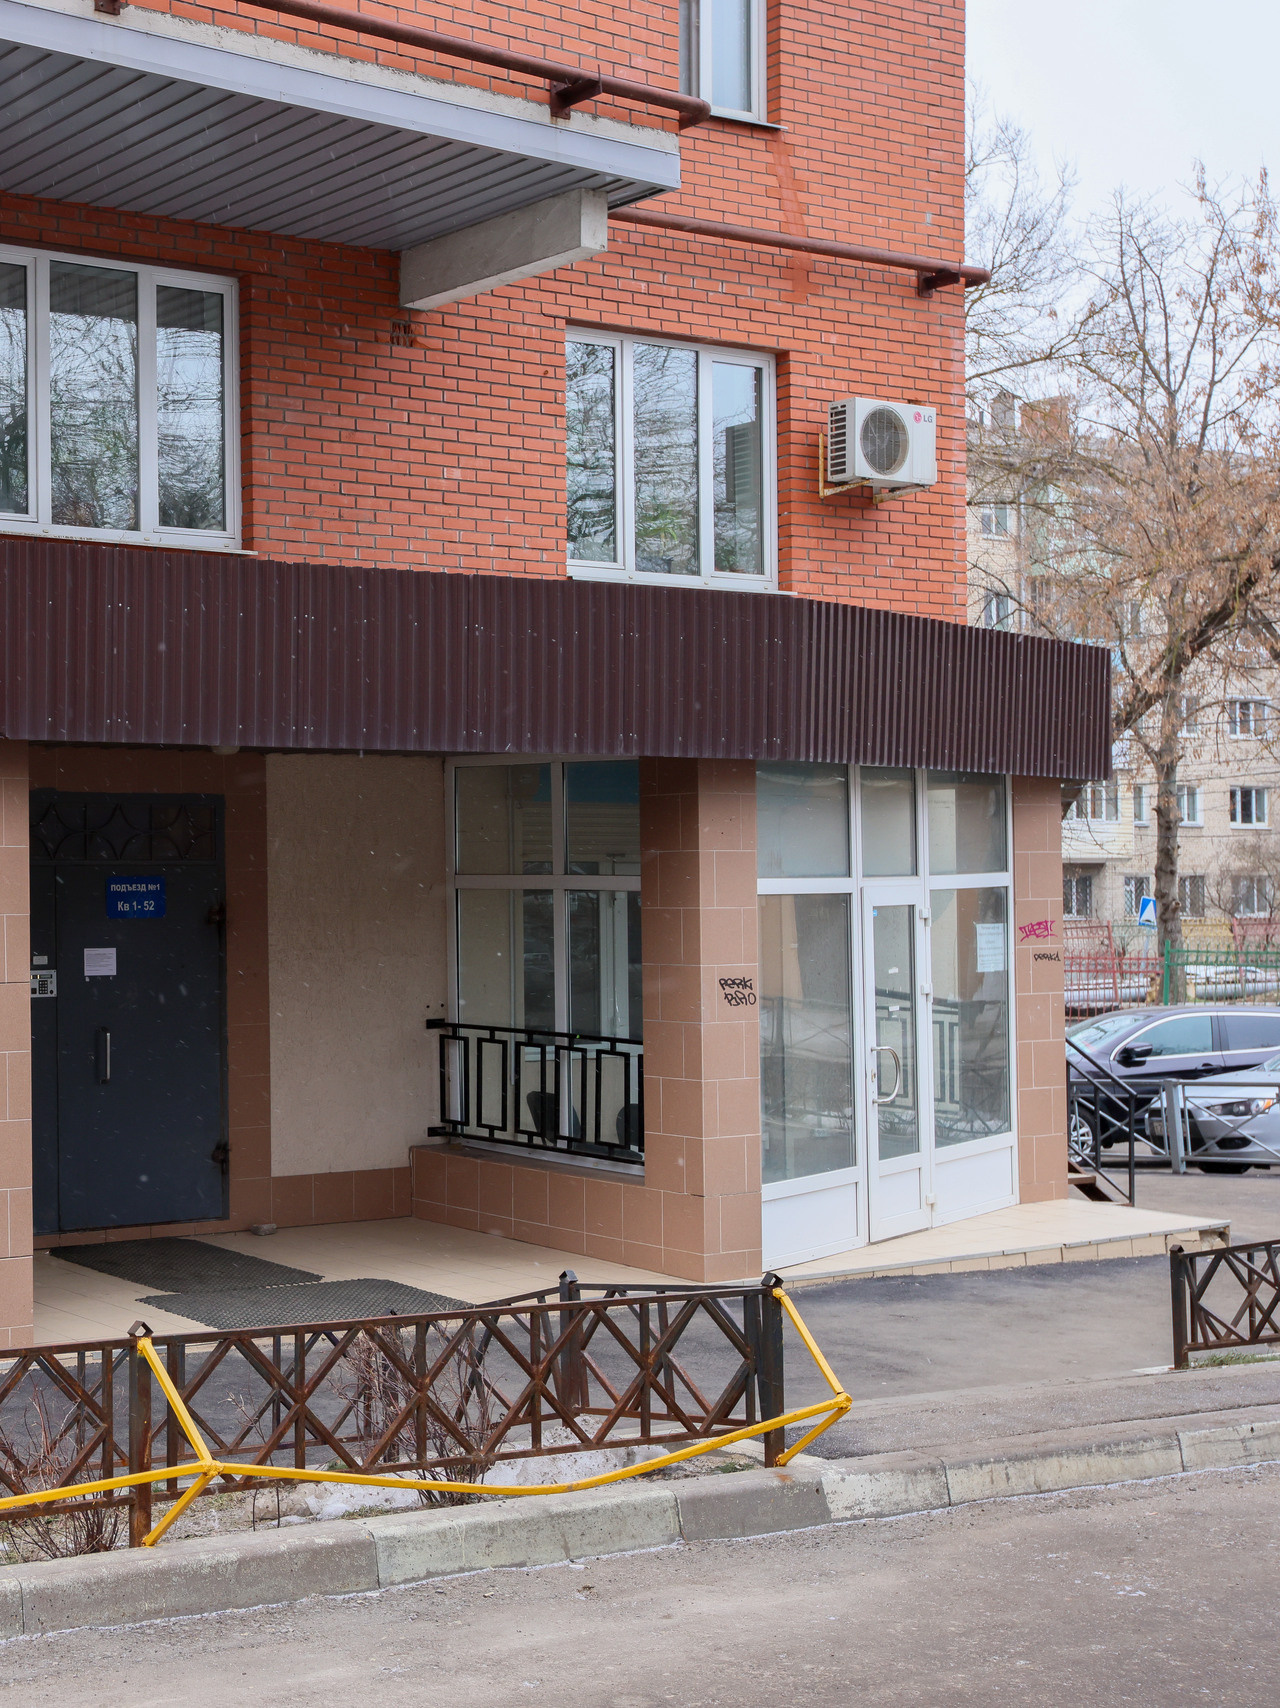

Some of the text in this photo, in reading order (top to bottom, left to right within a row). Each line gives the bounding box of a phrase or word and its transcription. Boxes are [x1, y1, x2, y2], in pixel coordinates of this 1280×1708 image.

[110, 884, 147, 892] ПОДЪЕЗД
[117, 901, 130, 911] Кв
[143, 900, 155, 911] 52
